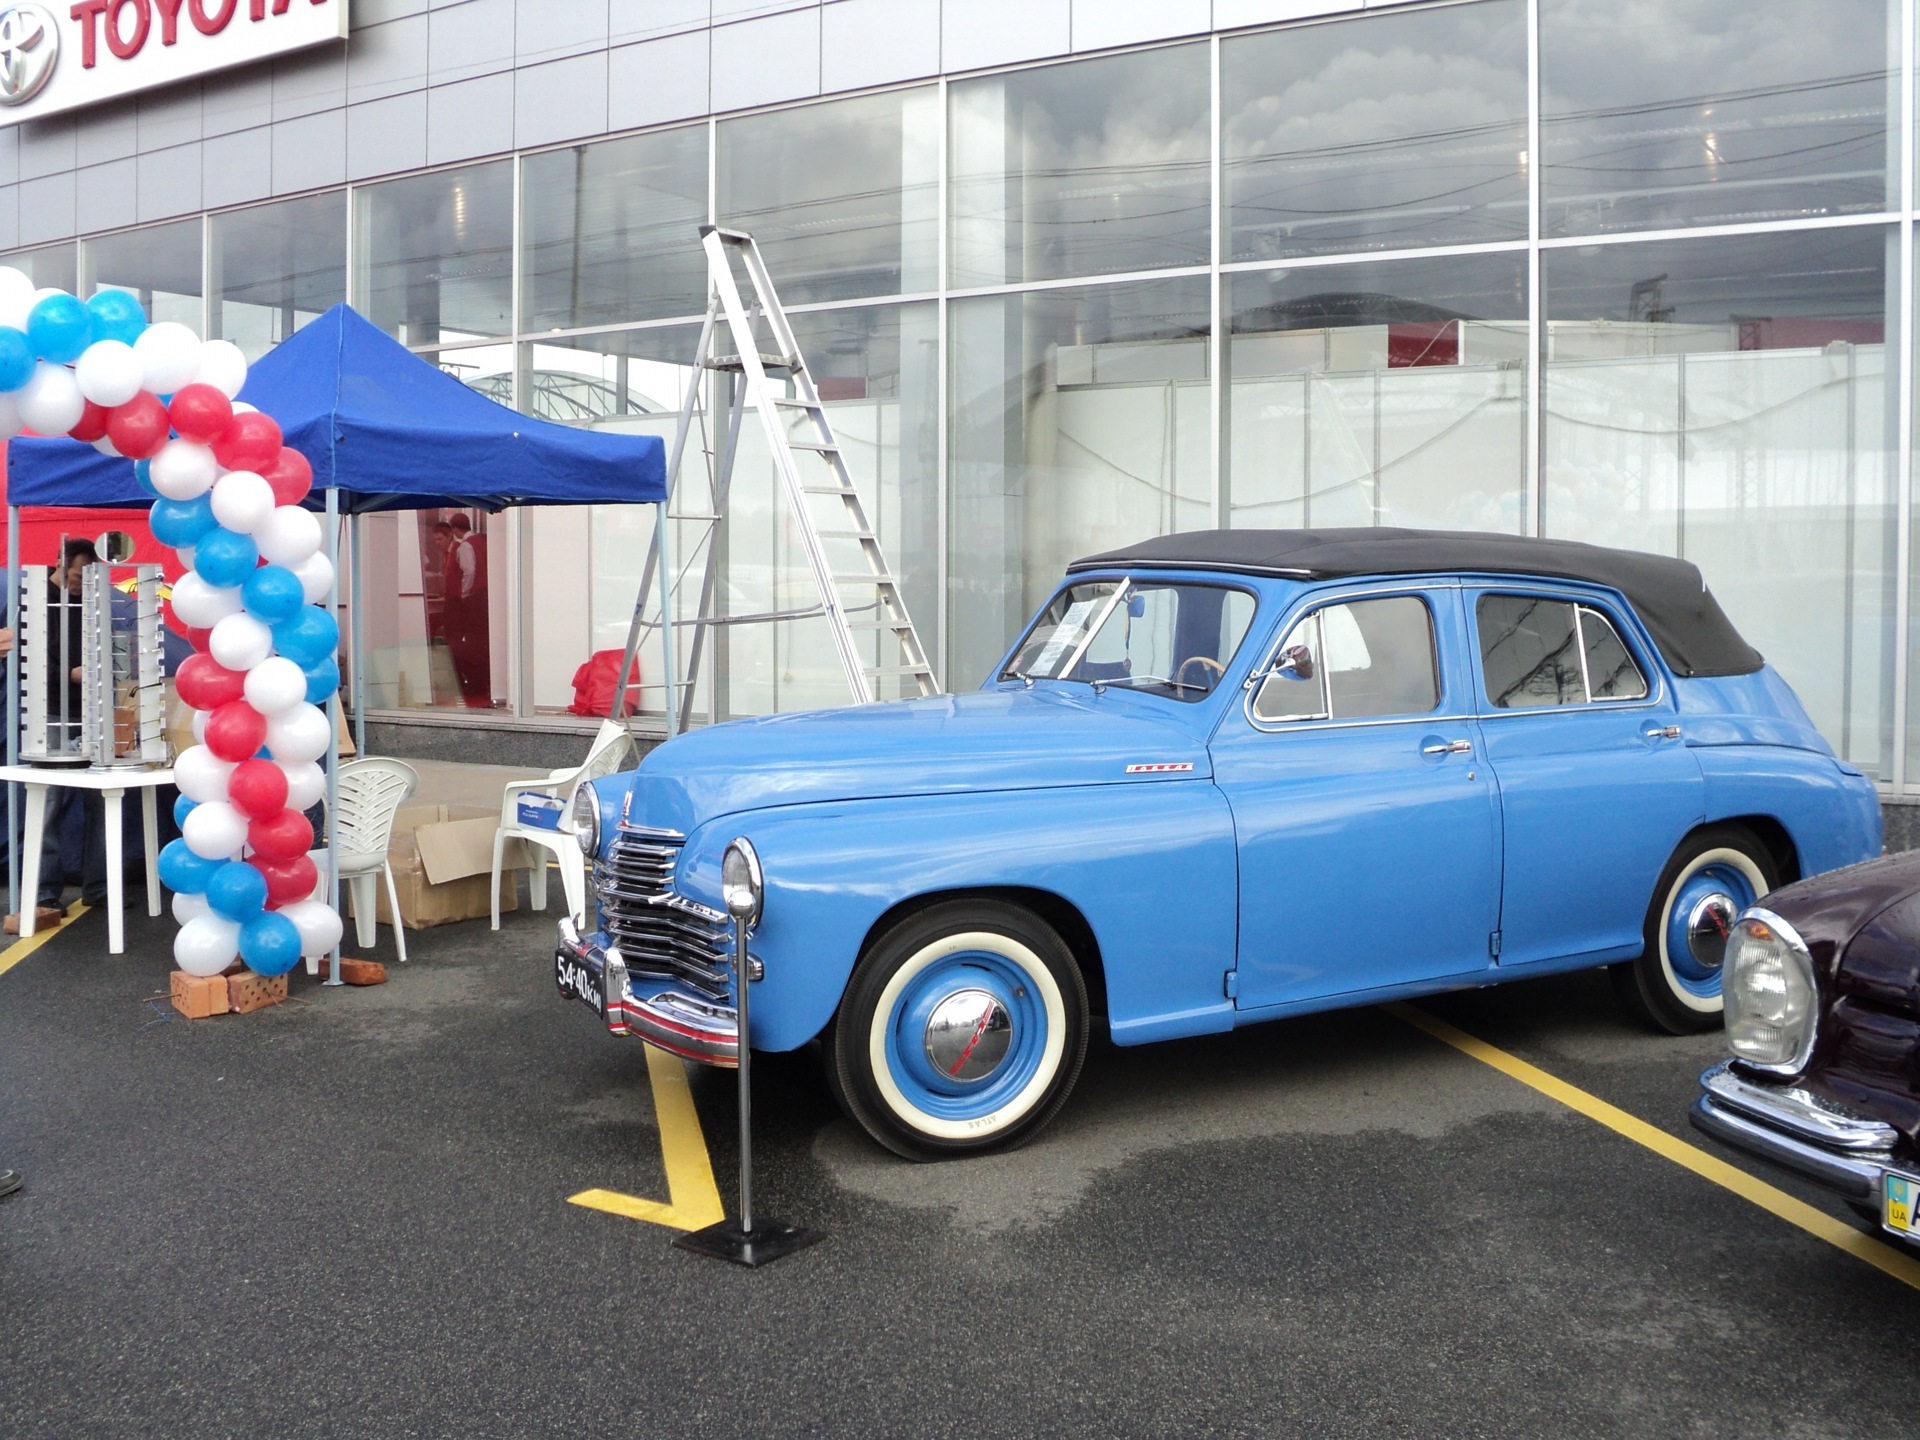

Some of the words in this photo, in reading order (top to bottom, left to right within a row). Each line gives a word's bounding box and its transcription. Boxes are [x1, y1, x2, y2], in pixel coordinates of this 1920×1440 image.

[70, 0, 328, 69] TOYO
[968, 1114, 997, 1129] ATLAS
[1892, 1208, 1907, 1223] UA
